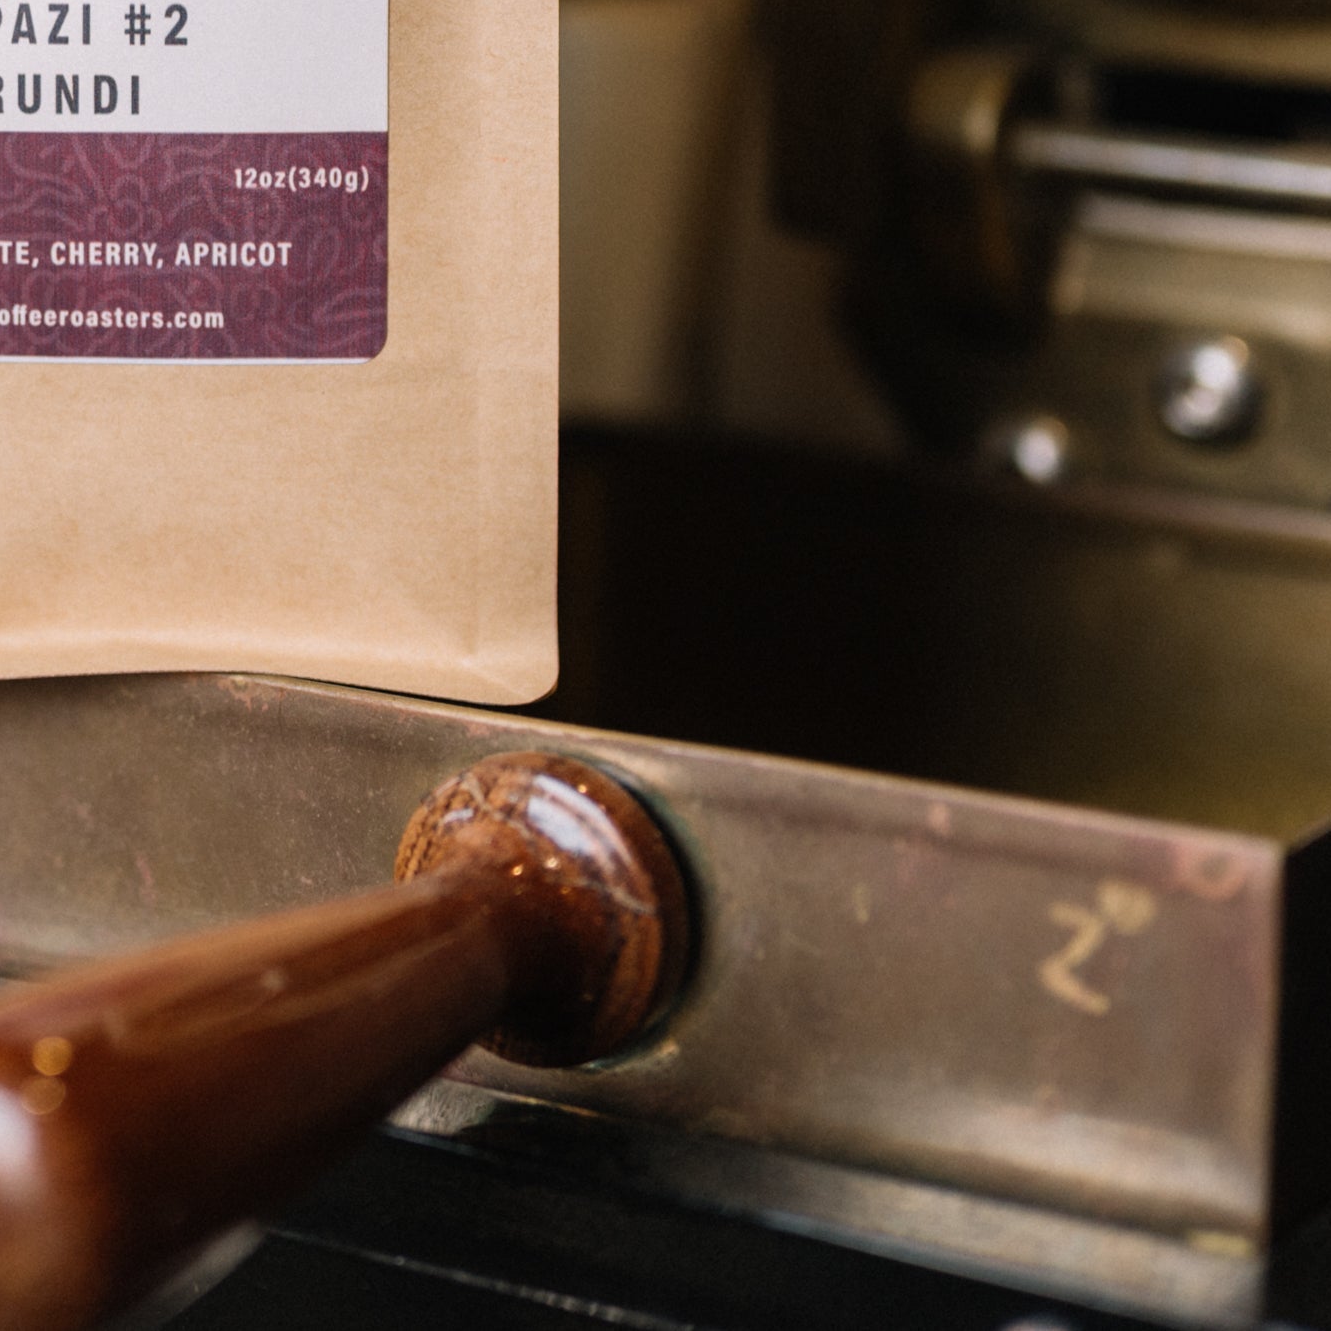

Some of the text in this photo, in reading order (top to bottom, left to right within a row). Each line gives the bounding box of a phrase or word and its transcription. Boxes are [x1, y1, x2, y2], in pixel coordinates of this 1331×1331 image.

[124, 3, 190, 46] #2
[233, 165, 370, 193] 12oz(340g)
[50, 241, 164, 269] CHERRY,
[174, 242, 292, 268] APRICOT
